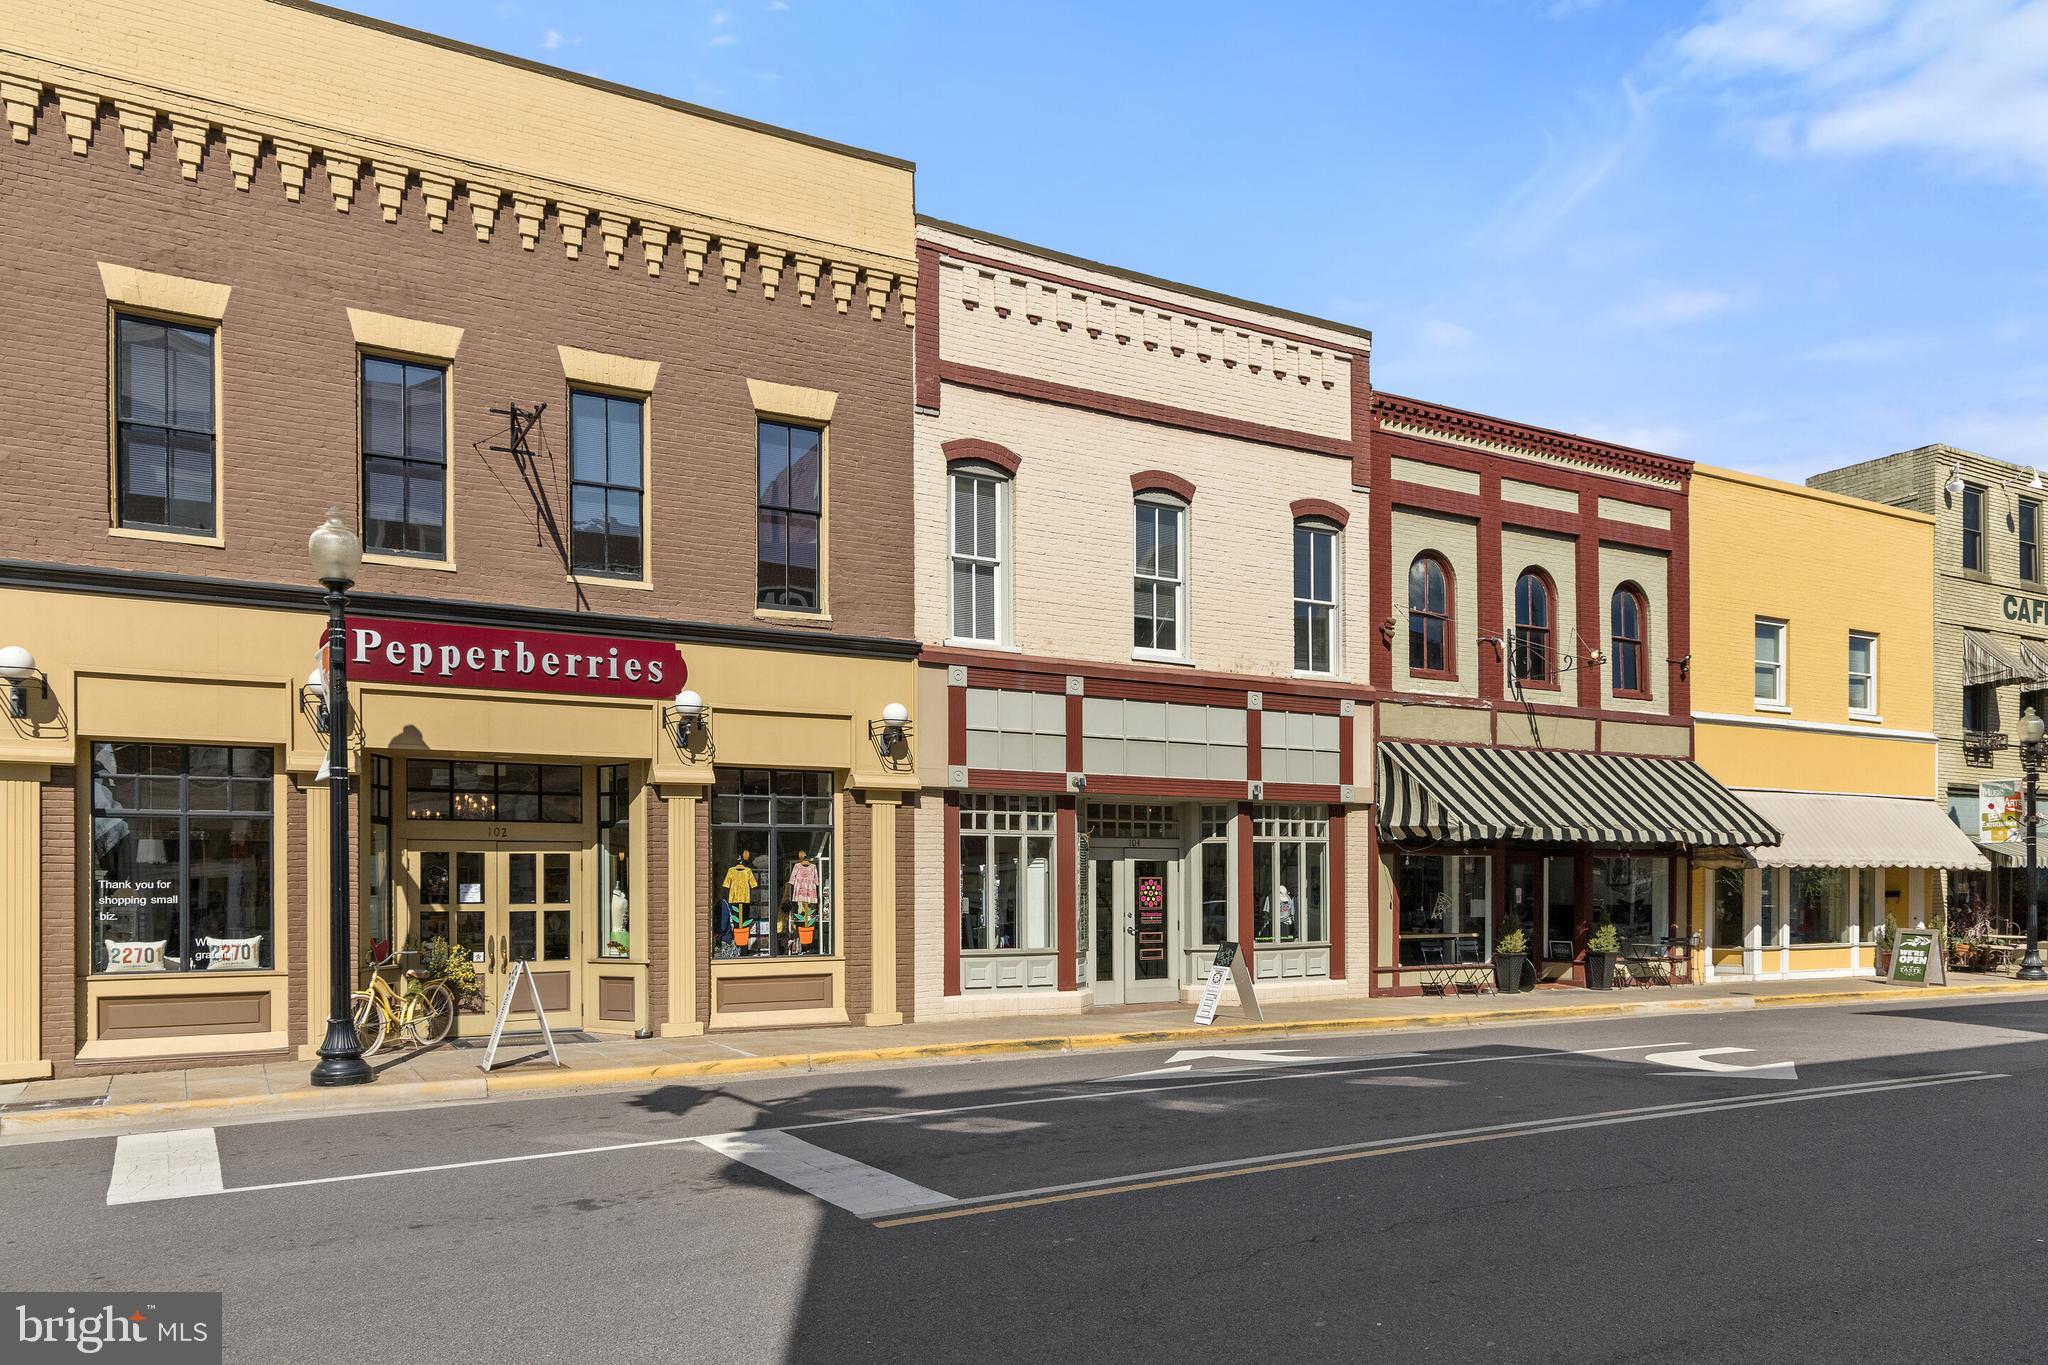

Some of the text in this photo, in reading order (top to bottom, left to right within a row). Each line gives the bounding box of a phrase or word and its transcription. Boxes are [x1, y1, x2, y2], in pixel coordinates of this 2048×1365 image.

[351, 628, 664, 683] Pepperberries
[488, 827, 508, 837] 102
[1128, 839, 1141, 847] 104
[98, 880, 172, 891] Thank you for
[98, 895, 178, 906] shopping small
[99, 912, 118, 921] biz.
[111, 946, 163, 964] 22701
[1898, 955, 1927, 965] OPEN
